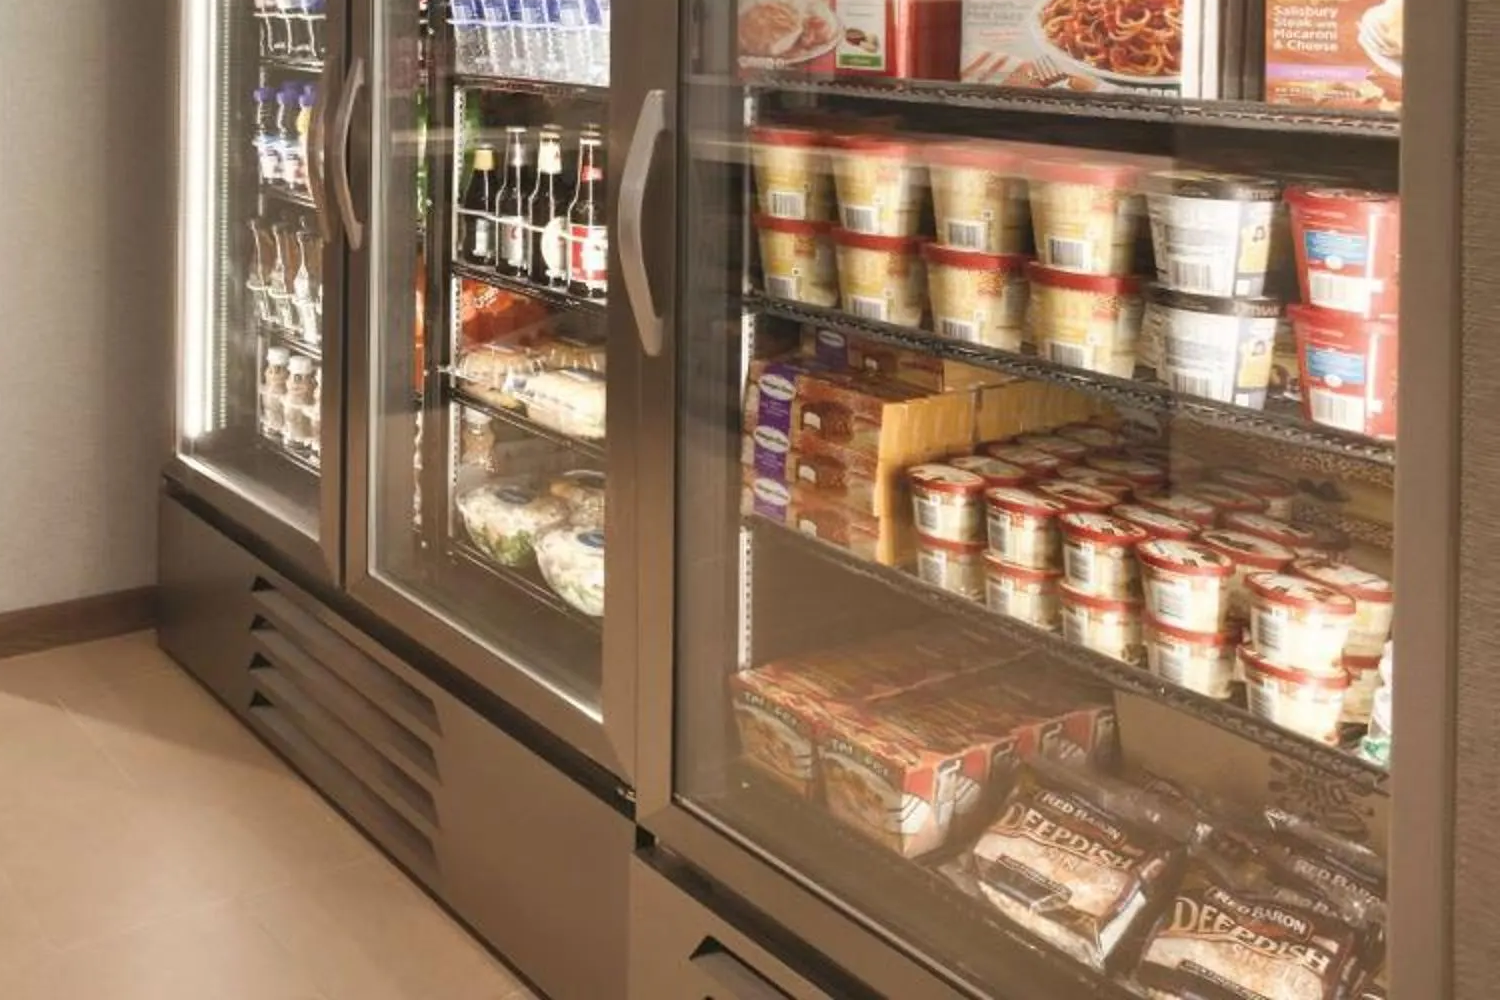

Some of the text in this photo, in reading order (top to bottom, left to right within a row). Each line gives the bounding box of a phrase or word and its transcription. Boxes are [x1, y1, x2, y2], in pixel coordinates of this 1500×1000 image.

[1273, 5, 1338, 19] Salisbury
[1273, 28, 1337, 41] Macaroni
[1251, 904, 1308, 937] BARON
